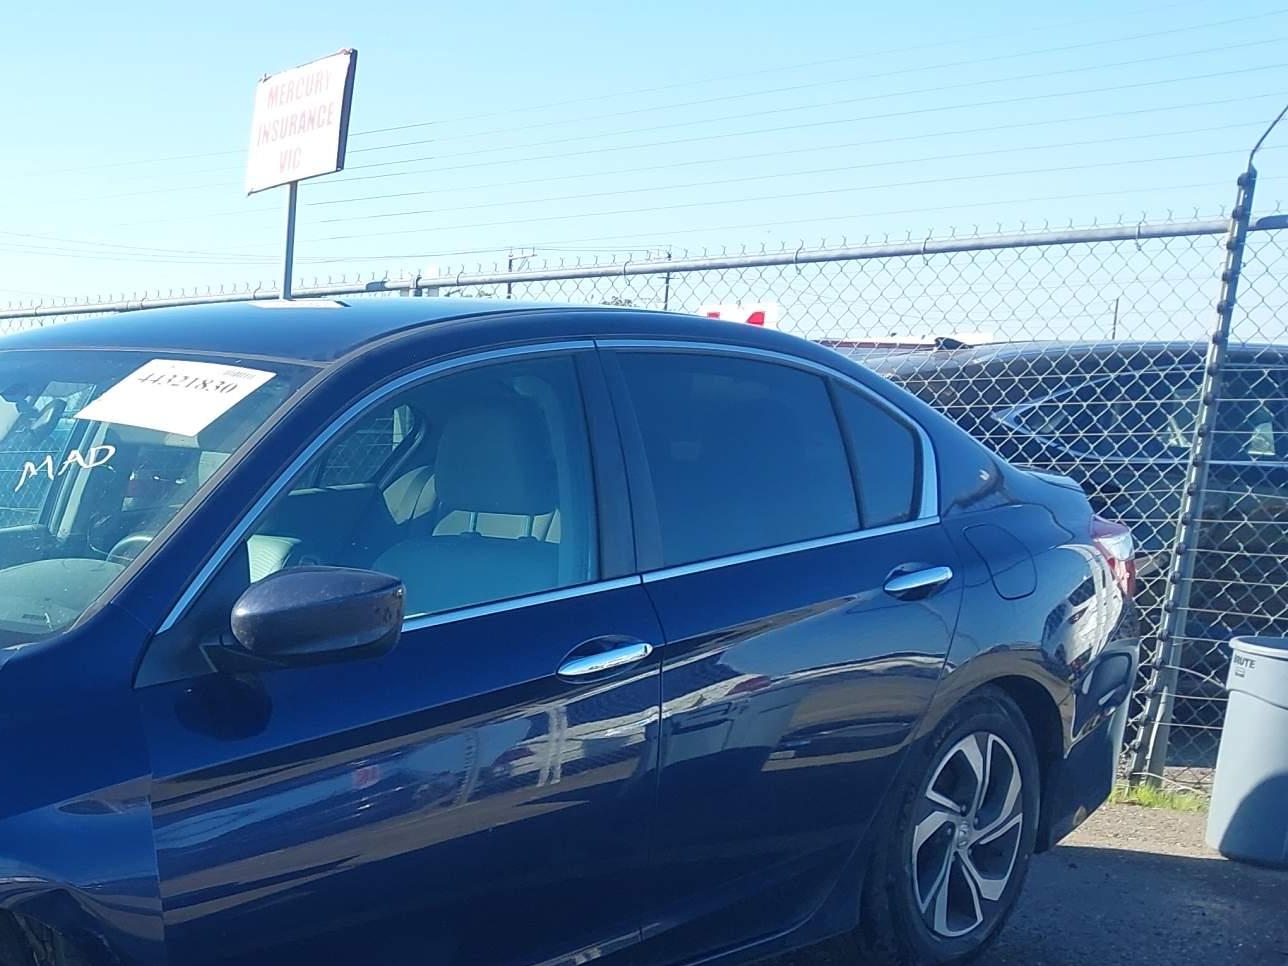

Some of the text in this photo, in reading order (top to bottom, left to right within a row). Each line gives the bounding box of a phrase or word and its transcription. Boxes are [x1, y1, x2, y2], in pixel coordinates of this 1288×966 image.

[267, 69, 333, 108] MERCURY
[257, 102, 334, 145] INSURANCE
[280, 147, 302, 173] VIC
[138, 371, 238, 394] 44321830
